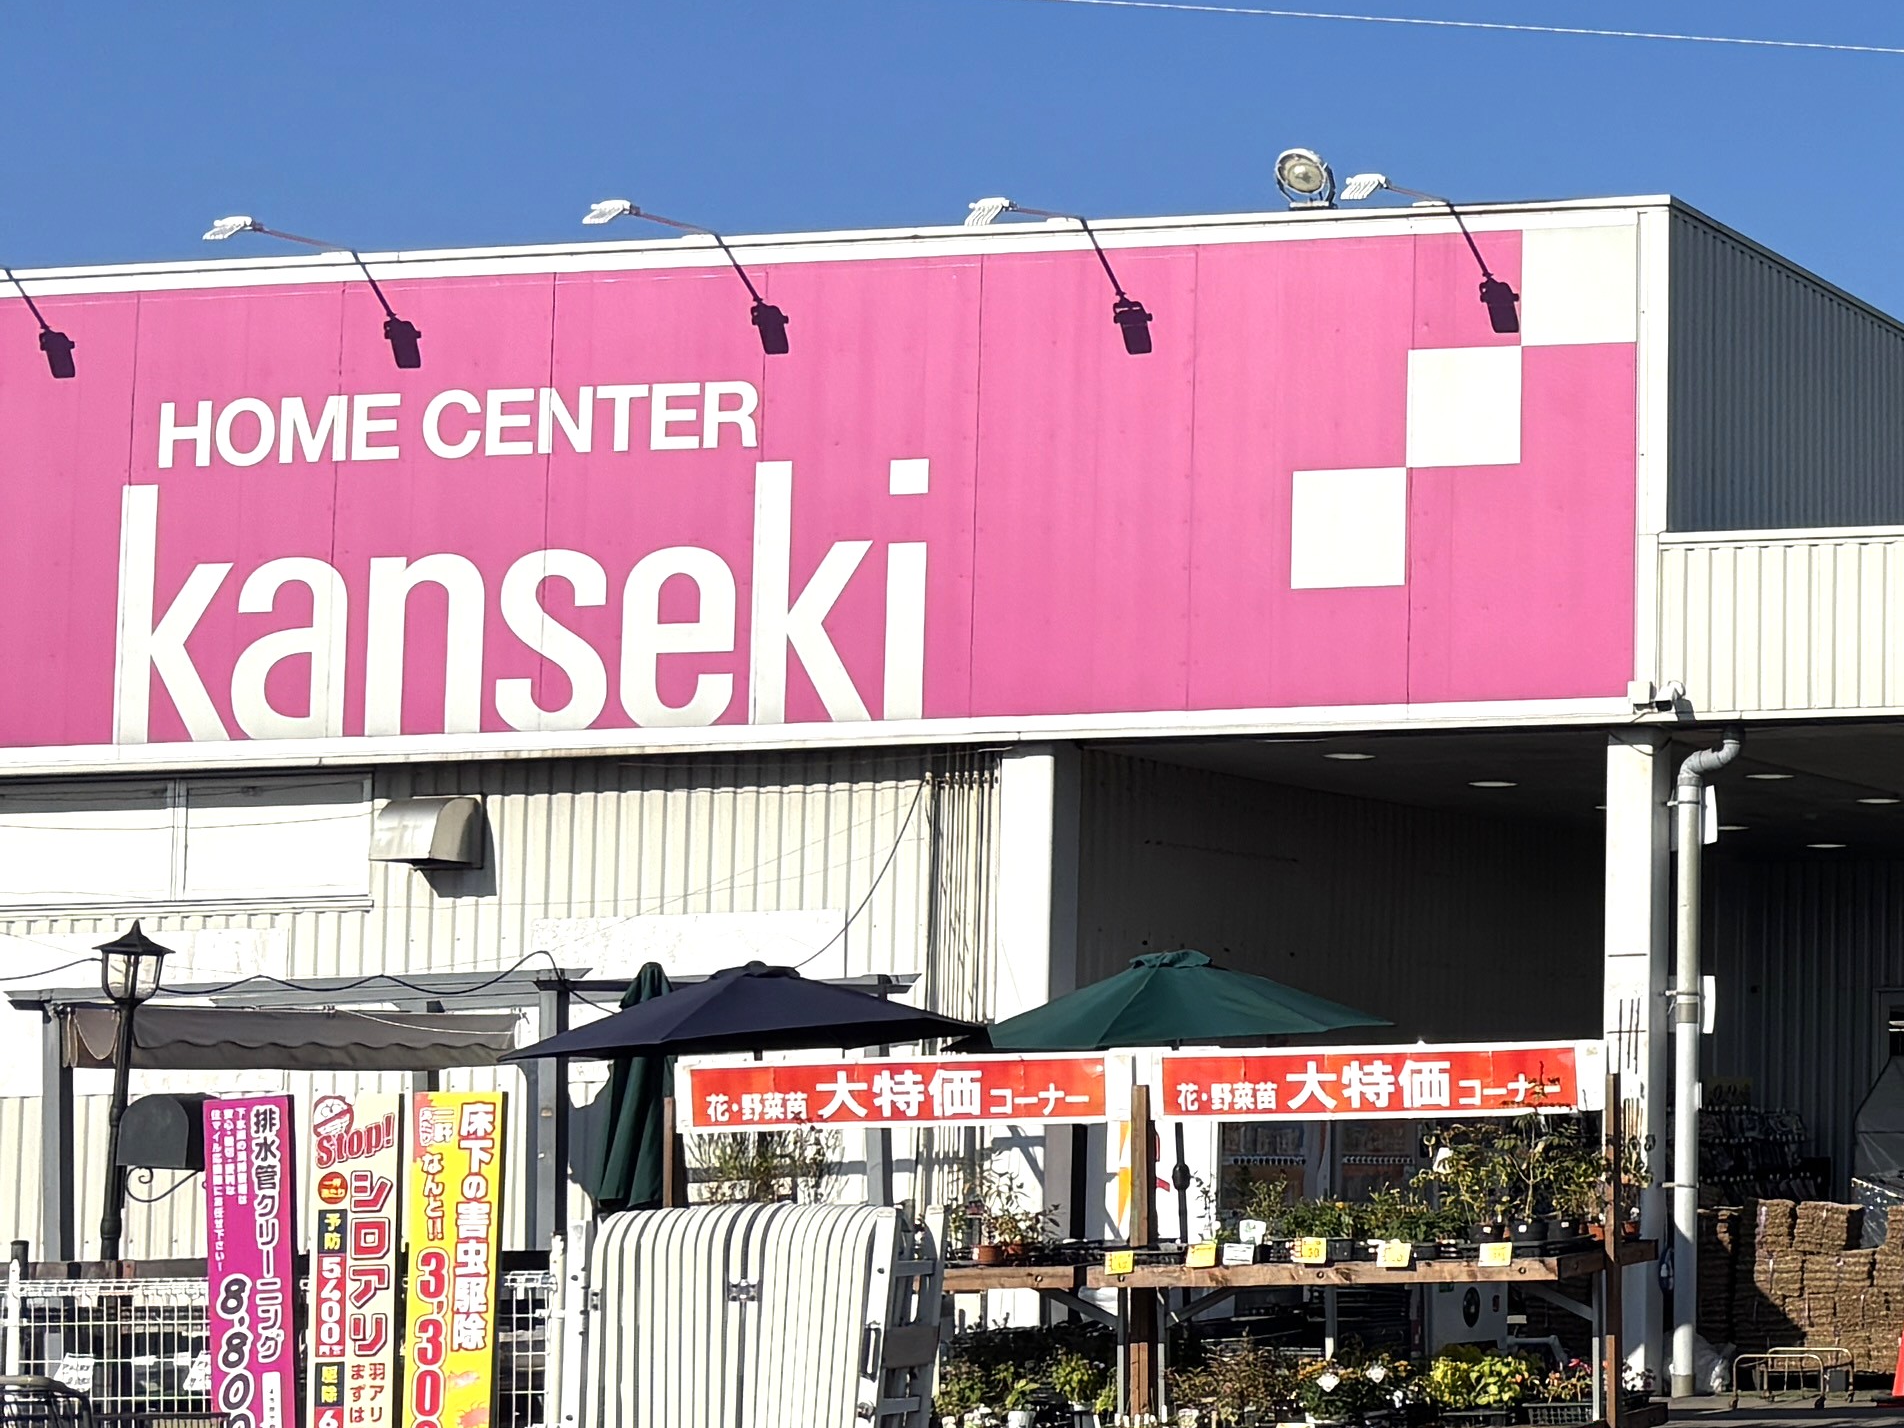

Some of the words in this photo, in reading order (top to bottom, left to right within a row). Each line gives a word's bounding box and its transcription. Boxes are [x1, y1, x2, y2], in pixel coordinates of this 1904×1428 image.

[158, 392, 402, 469] HOME
[422, 380, 760, 459] CENTER
[113, 457, 930, 745] kanseki
[252, 1105, 284, 1363] 排水管クリーニング
[315, 1112, 396, 1170] Stop!
[324, 1212, 341, 1250] 予防
[450, 1101, 496, 1352] 床下の害虫駆除
[349, 1170, 394, 1358] シロアリ
